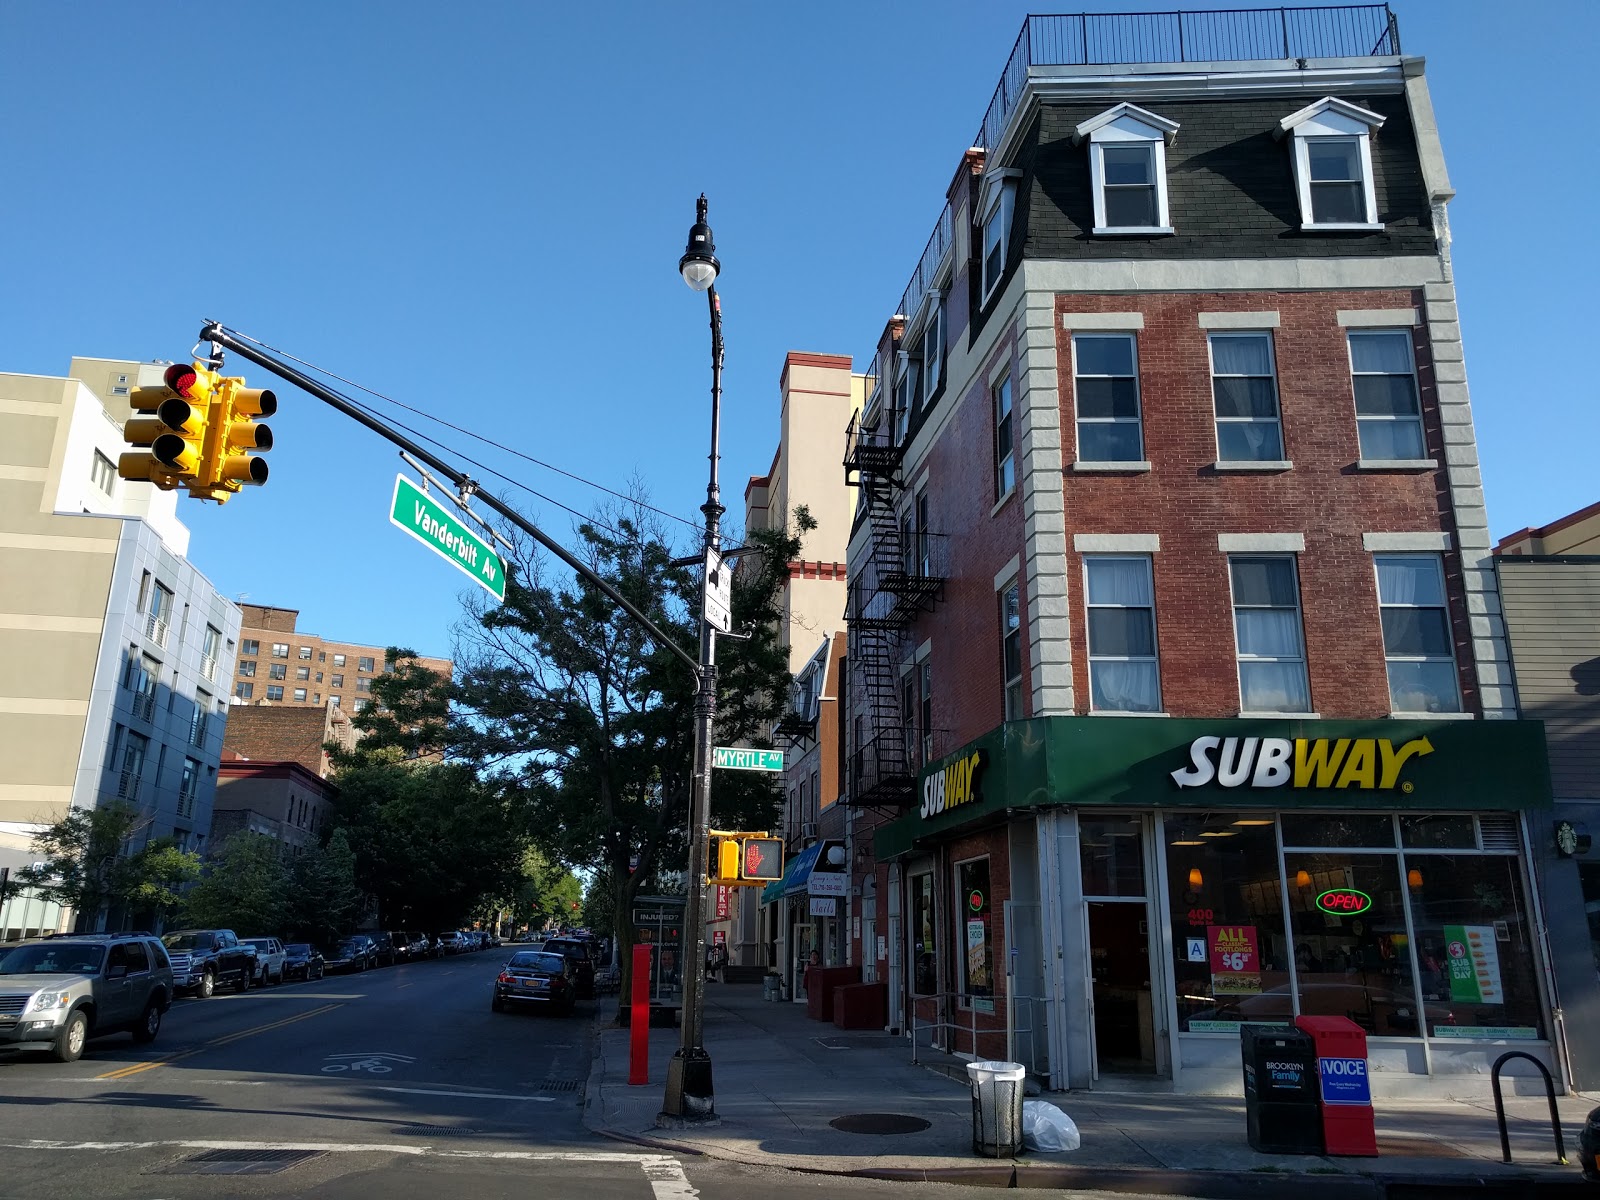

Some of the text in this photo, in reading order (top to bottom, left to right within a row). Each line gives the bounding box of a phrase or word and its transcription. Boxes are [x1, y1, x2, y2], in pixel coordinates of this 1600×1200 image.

[415, 499, 496, 581] Vanderbilt Av
[717, 750, 780, 768] MYRTLE AV
[1171, 735, 1435, 789] SUBWAY
[920, 750, 980, 819] SUBWAY
[811, 900, 834, 914] Nails
[1323, 893, 1363, 910] OPEN
[1187, 908, 1214, 920] 400
[1218, 928, 1248, 942] ALL
[1190, 942, 1203, 956] A
[1451, 959, 1469, 967] SUB
[1454, 971, 1471, 979] DAY
[1266, 1061, 1304, 1071] BROOKLYN
[1325, 1060, 1365, 1075] VOICE
[1271, 1070, 1301, 1082] Family
